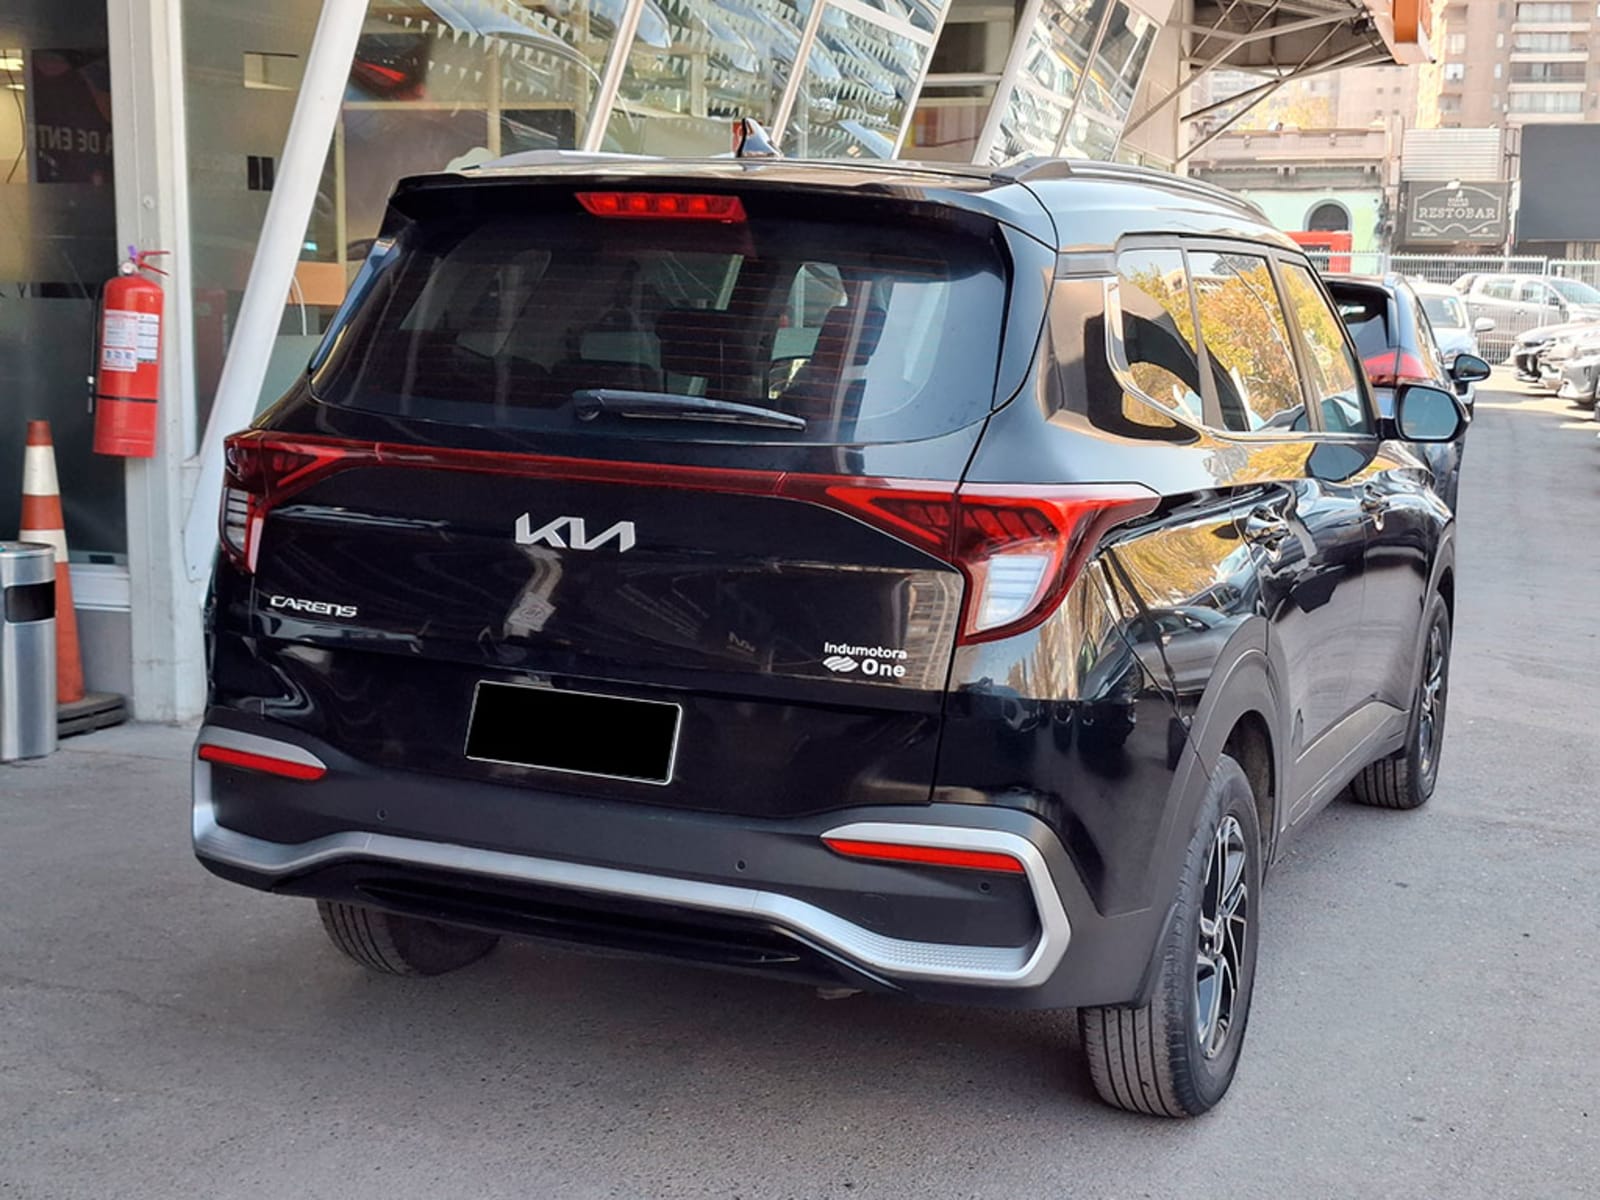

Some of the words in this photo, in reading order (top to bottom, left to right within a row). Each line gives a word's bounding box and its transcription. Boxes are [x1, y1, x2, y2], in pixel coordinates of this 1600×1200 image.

[1418, 207, 1496, 219] RESTOBAR
[515, 512, 636, 553] KIA
[270, 595, 358, 617] CARENS
[824, 642, 908, 660] Indumotora
[861, 658, 906, 677] One
